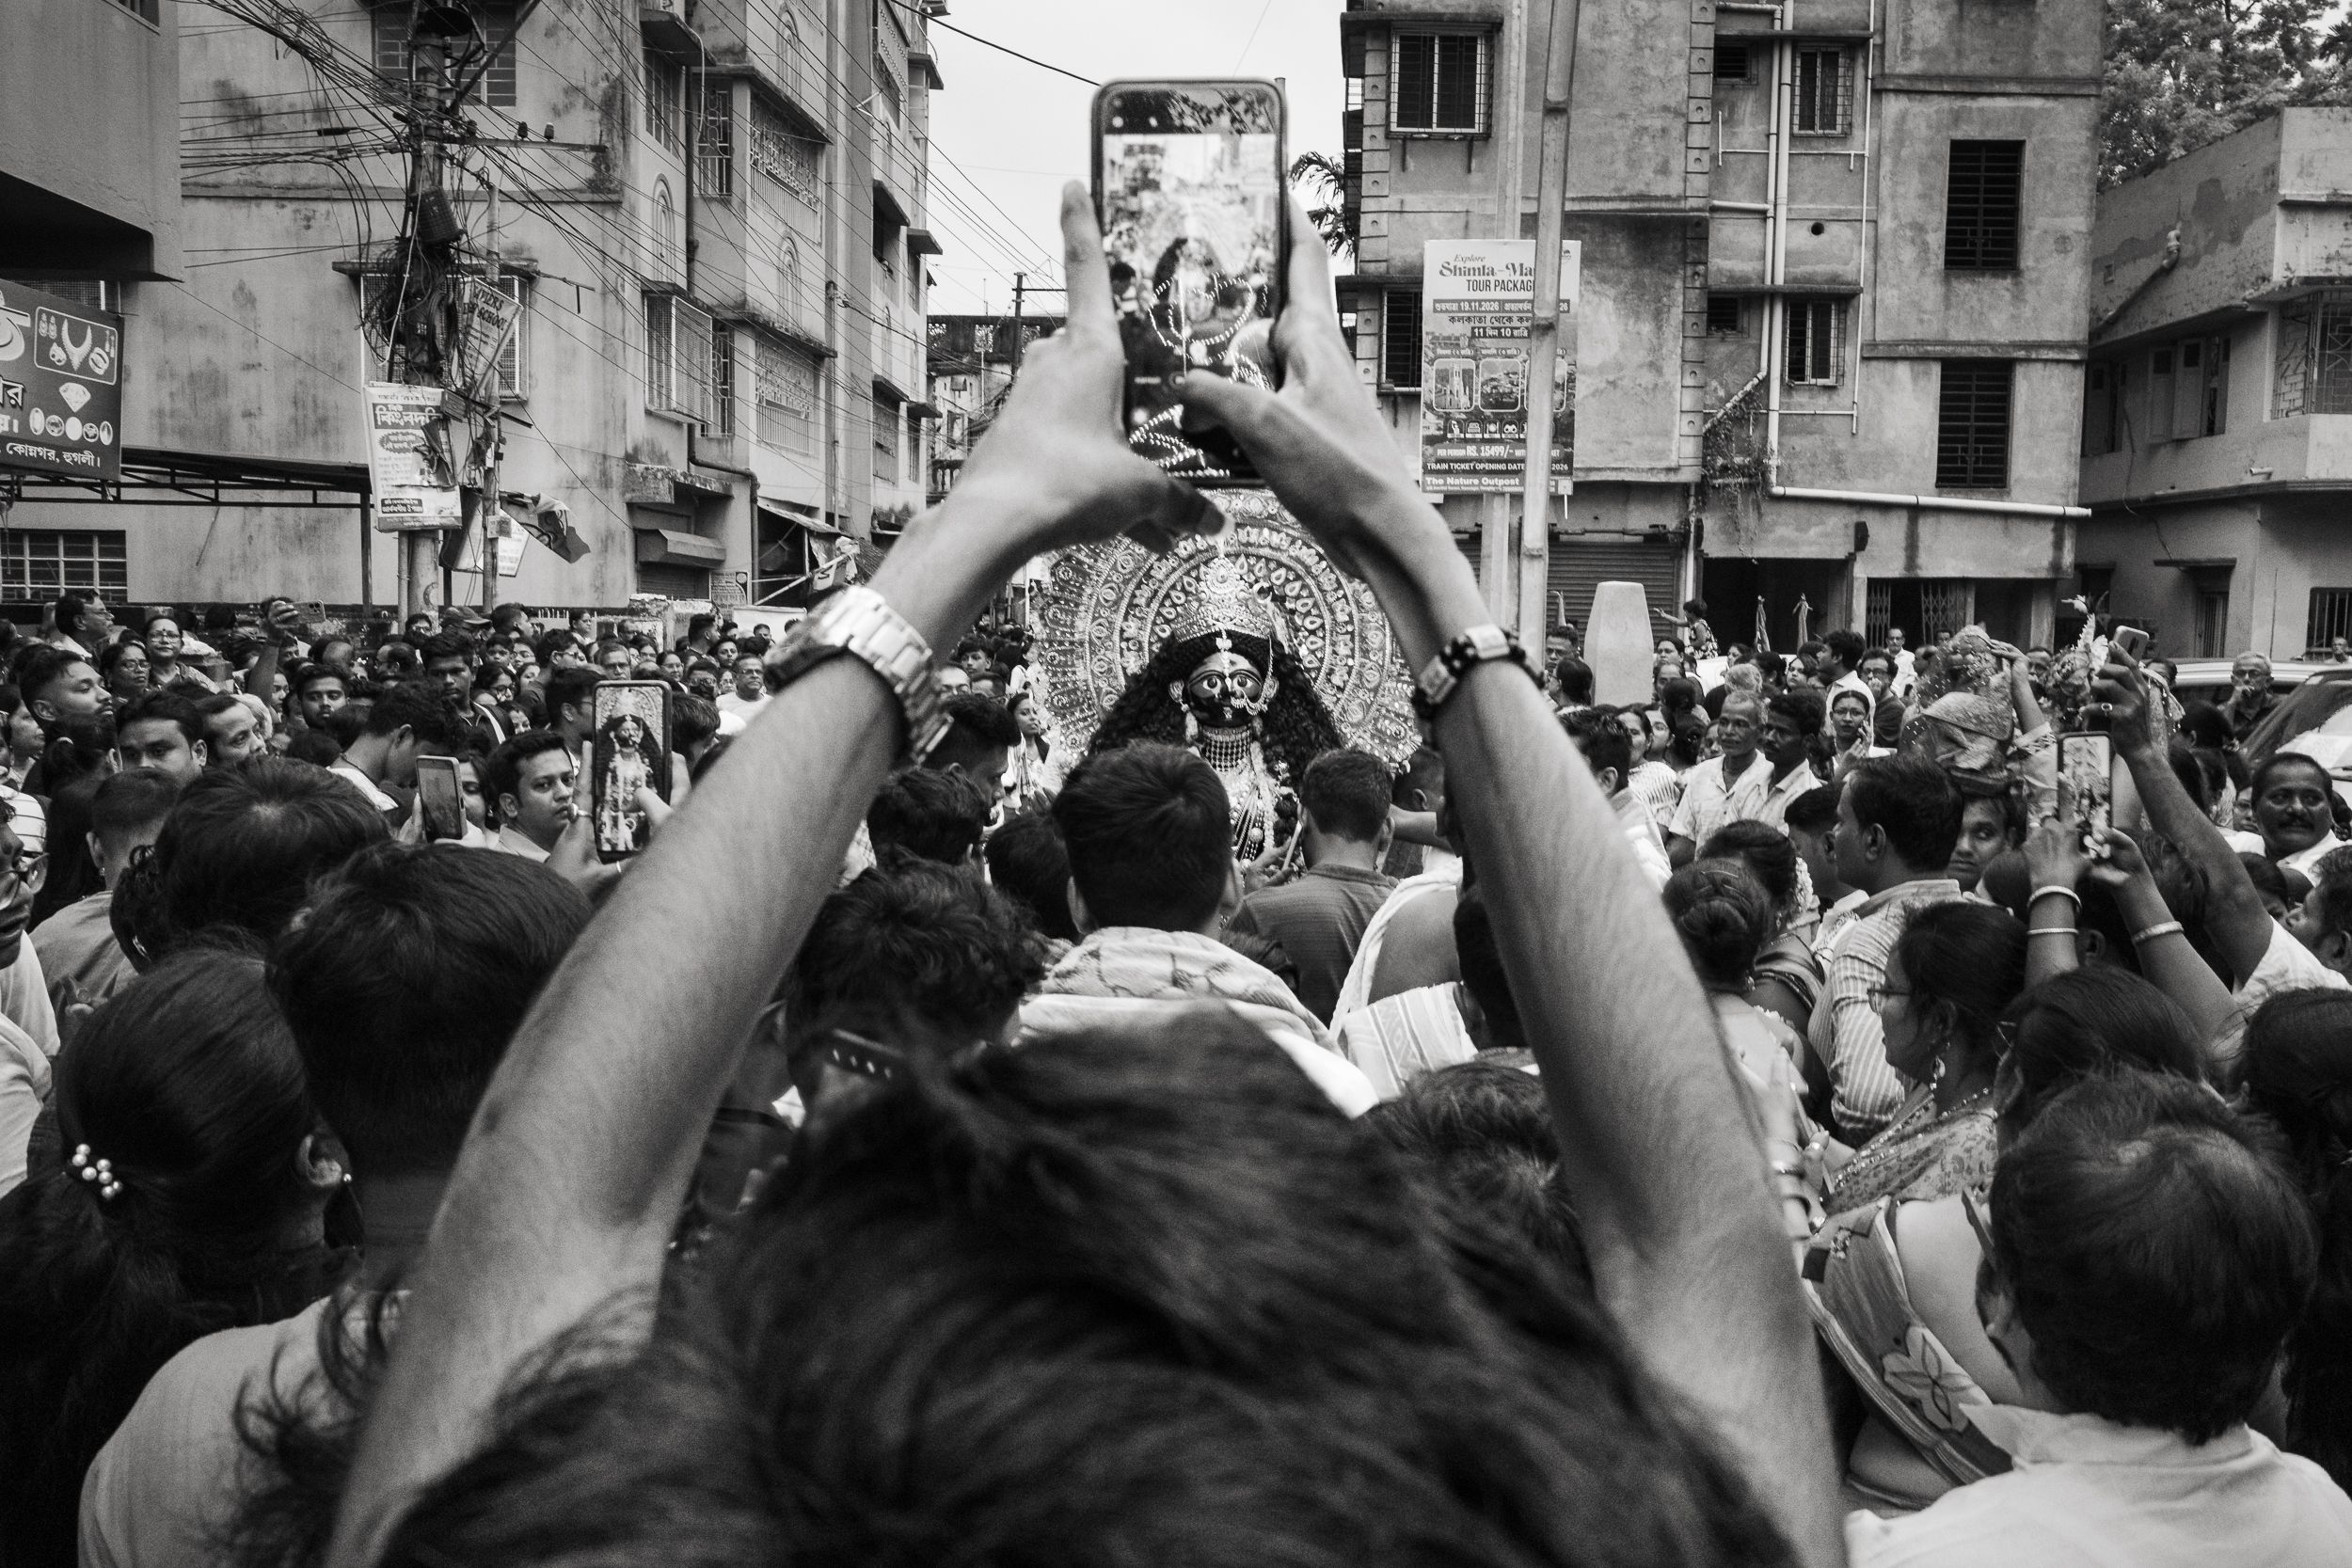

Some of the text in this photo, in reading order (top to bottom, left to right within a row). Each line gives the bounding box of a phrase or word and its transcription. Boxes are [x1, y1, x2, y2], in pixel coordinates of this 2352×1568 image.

[1454, 254, 1486, 263] Explore
[1438, 261, 1535, 277] Shimla-Ma
[1467, 279, 1535, 292] TOUR PACKAG
[1460, 301, 1499, 311] 19.11.2026
[1559, 302, 1569, 311] 26
[1448, 315, 1532, 325] কলকাতা থেকে কল
[1473, 327, 1484, 337] 11
[1486, 326, 1498, 337] দিন
[1501, 327, 1511, 337] 10
[7, 442, 60, 464] কোন্নগর,
[1467, 445, 1479, 457] RS.
[1515, 449, 1526, 457] WIT
[1425, 477, 1520, 487] The Nature Outpost
